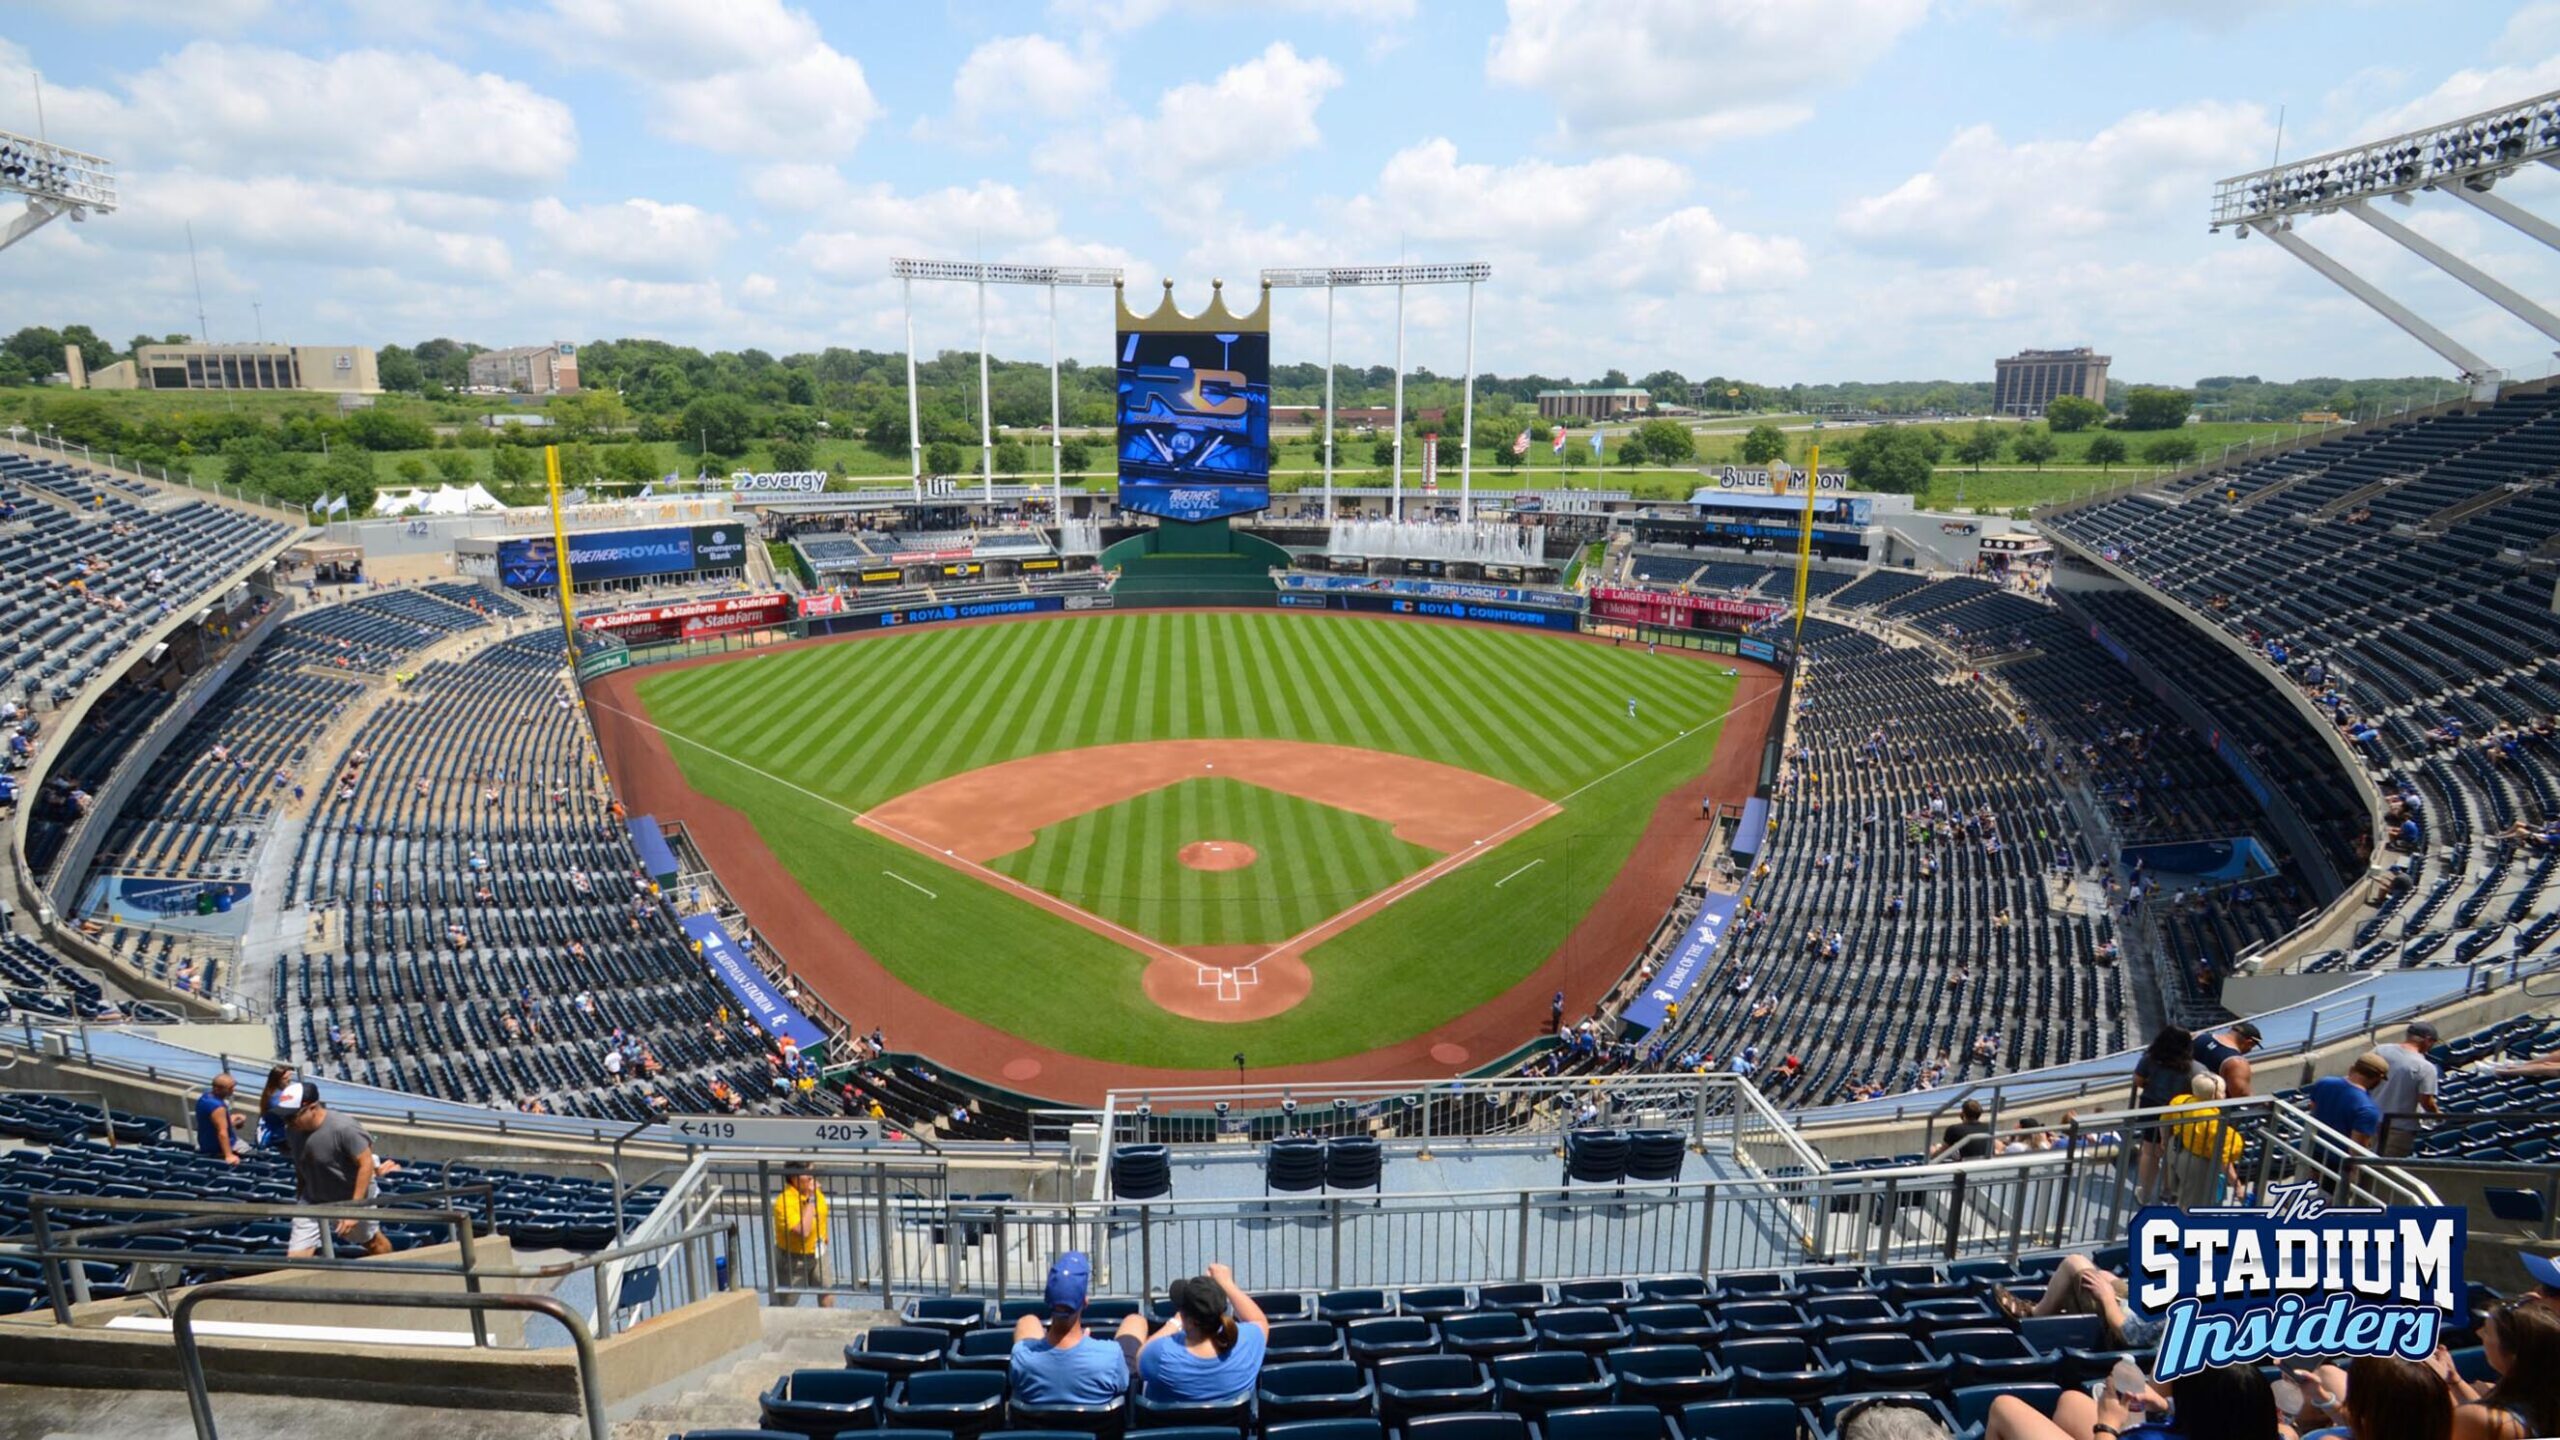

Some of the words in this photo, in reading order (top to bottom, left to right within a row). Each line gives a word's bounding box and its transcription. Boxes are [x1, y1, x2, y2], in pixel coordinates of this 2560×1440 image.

[757, 473, 825, 491] evergy
[1721, 466, 1765, 488] BLUE
[1169, 501, 1219, 509] ROYAL
[1543, 499, 1590, 512] PATIO
[407, 521, 428, 536] 42
[568, 549, 619, 563] TOGETHER
[619, 543, 679, 558] ROYAL
[697, 543, 742, 554] Commerce
[709, 551, 731, 561] Bank
[1430, 584, 1459, 596] PEPSI
[1461, 588, 1498, 599] PORCH
[960, 601, 1035, 617] COUNTDOWN
[1699, 599, 1717, 610] THE
[1718, 602, 1755, 616] LEADER
[1468, 607, 1546, 624] COUNTDOWN
[1665, 965, 1690, 990] HOME
[1685, 943, 1705, 958] THE
[713, 950, 750, 984] KAUFFMAN
[740, 980, 777, 1014] STADIUM
[699, 1123, 735, 1138] 419
[816, 1125, 850, 1140] 420
